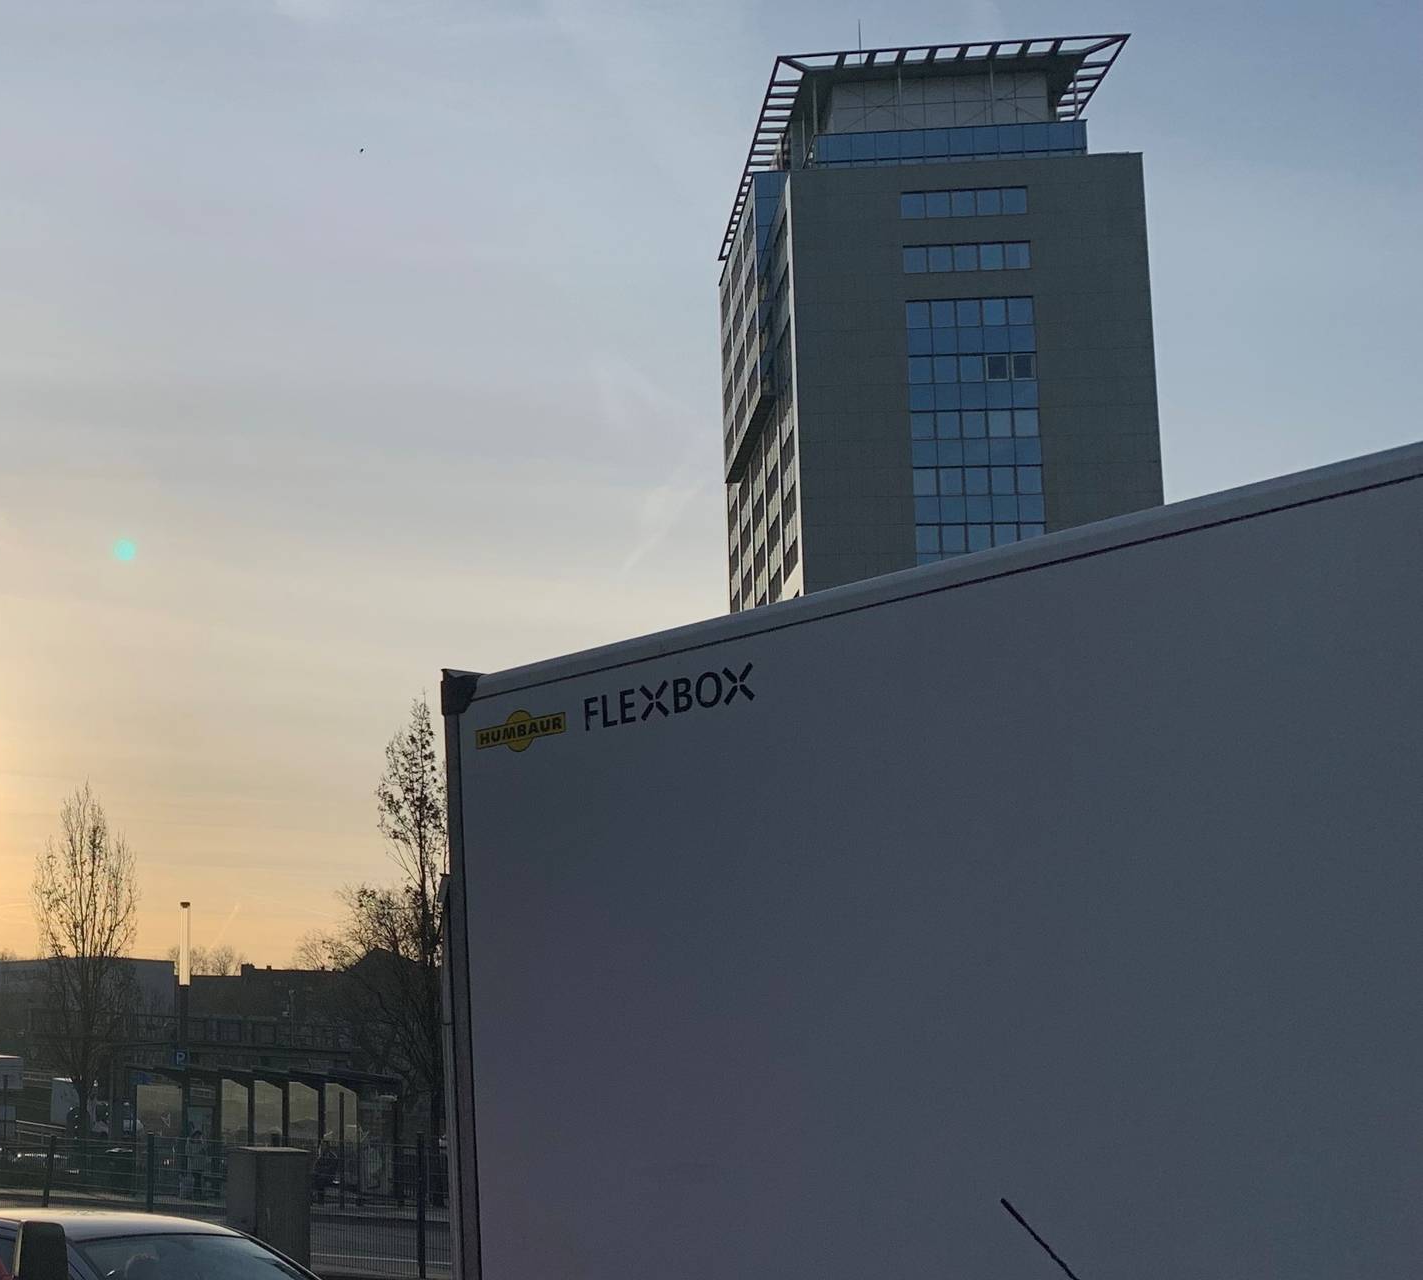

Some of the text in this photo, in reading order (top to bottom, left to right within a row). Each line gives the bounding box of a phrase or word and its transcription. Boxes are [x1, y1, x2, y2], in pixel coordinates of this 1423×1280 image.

[583, 662, 756, 731] FLEXBOX
[479, 718, 563, 745] HUMBAUR
[176, 1052, 186, 1065] P
